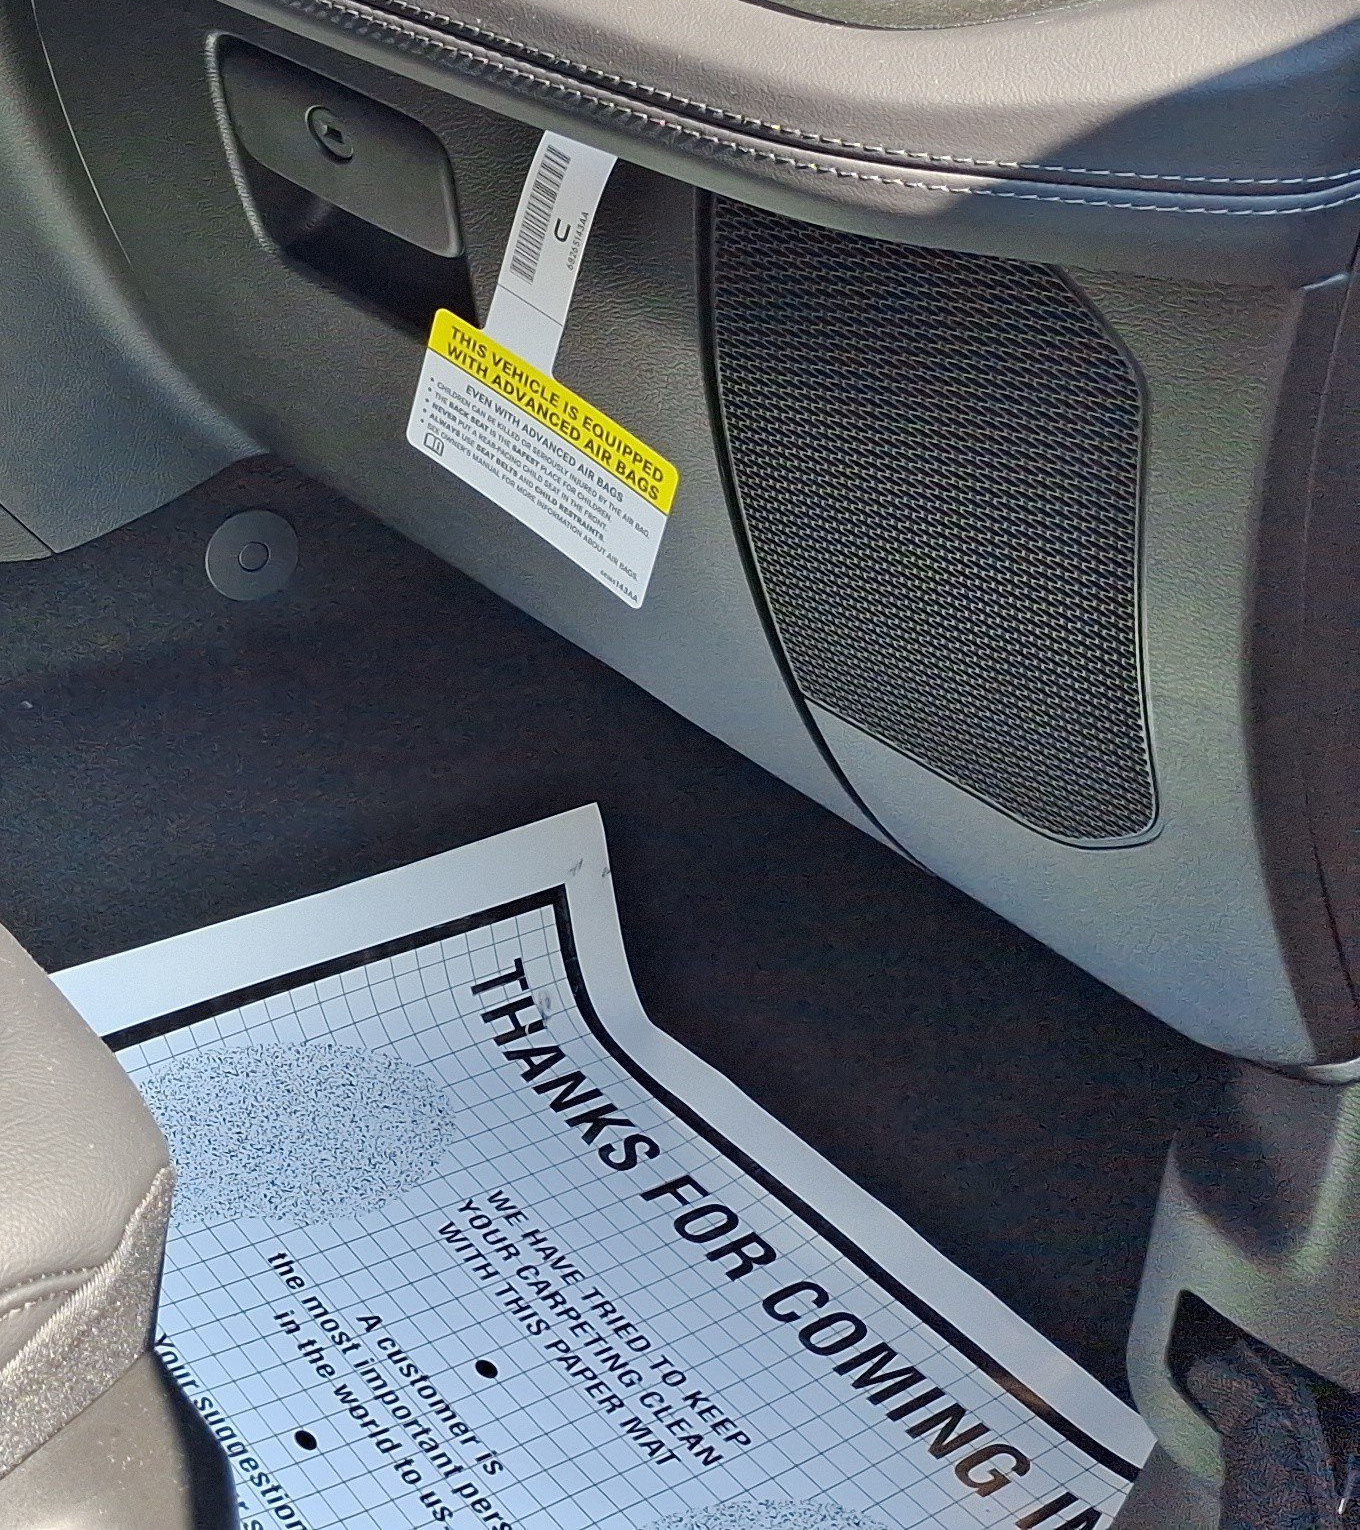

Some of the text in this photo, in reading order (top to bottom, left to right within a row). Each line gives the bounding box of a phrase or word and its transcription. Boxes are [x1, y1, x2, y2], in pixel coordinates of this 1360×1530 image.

[554, 218, 571, 242] U
[429, 409, 461, 438] ALWAYS
[475, 442, 495, 461] SEAT
[495, 456, 518, 478] BELTS
[518, 472, 534, 489] AND
[534, 484, 558, 507] CHILD
[431, 400, 457, 424] NEVER
[457, 418, 471, 433] PUT
[522, 463, 543, 484] CHILD
[569, 498, 583, 513] THE
[445, 340, 661, 502] WITH ADVANCED AIR BAGS
[448, 399, 469, 420] BACK
[470, 415, 488, 433] SEAT
[511, 443, 539, 469] SAFEST
[539, 464, 561, 485] PLACE
[562, 480, 576, 495] FOR
[449, 324, 665, 484] THIS VEHICLE IS EQUIPPED
[465, 383, 624, 503] EVEN WITH ADVANCED AIR BAGS
[471, 403, 486, 419] CAN
[496, 421, 520, 443] KILLED
[520, 438, 531, 451] OR
[531, 445, 568, 477] SERIOUSLY
[568, 472, 597, 498] INJURED
[607, 501, 621, 517] THE
[471, 452, 501, 478] MANUAL
[501, 473, 515, 489] FOR
[515, 483, 536, 504] MORE
[582, 533, 606, 556] ABOUT
[470, 957, 1103, 1530] THANKS FOR COMING I
[486, 1189, 752, 1447] WE HAVE TRIED TO KEEP
[267, 1251, 306, 1291] the
[301, 1295, 361, 1356] most
[354, 1356, 463, 1487] important
[273, 1310, 302, 1336] in
[297, 1338, 337, 1380] the
[333, 1382, 403, 1455] world
[394, 1457, 423, 1486] to
[356, 1313, 505, 1476] A customer is
[437, 1220, 682, 1466] WITH THIS PAPER MAT
[457, 1197, 725, 1468] YOUR CARPETING CLEAN
